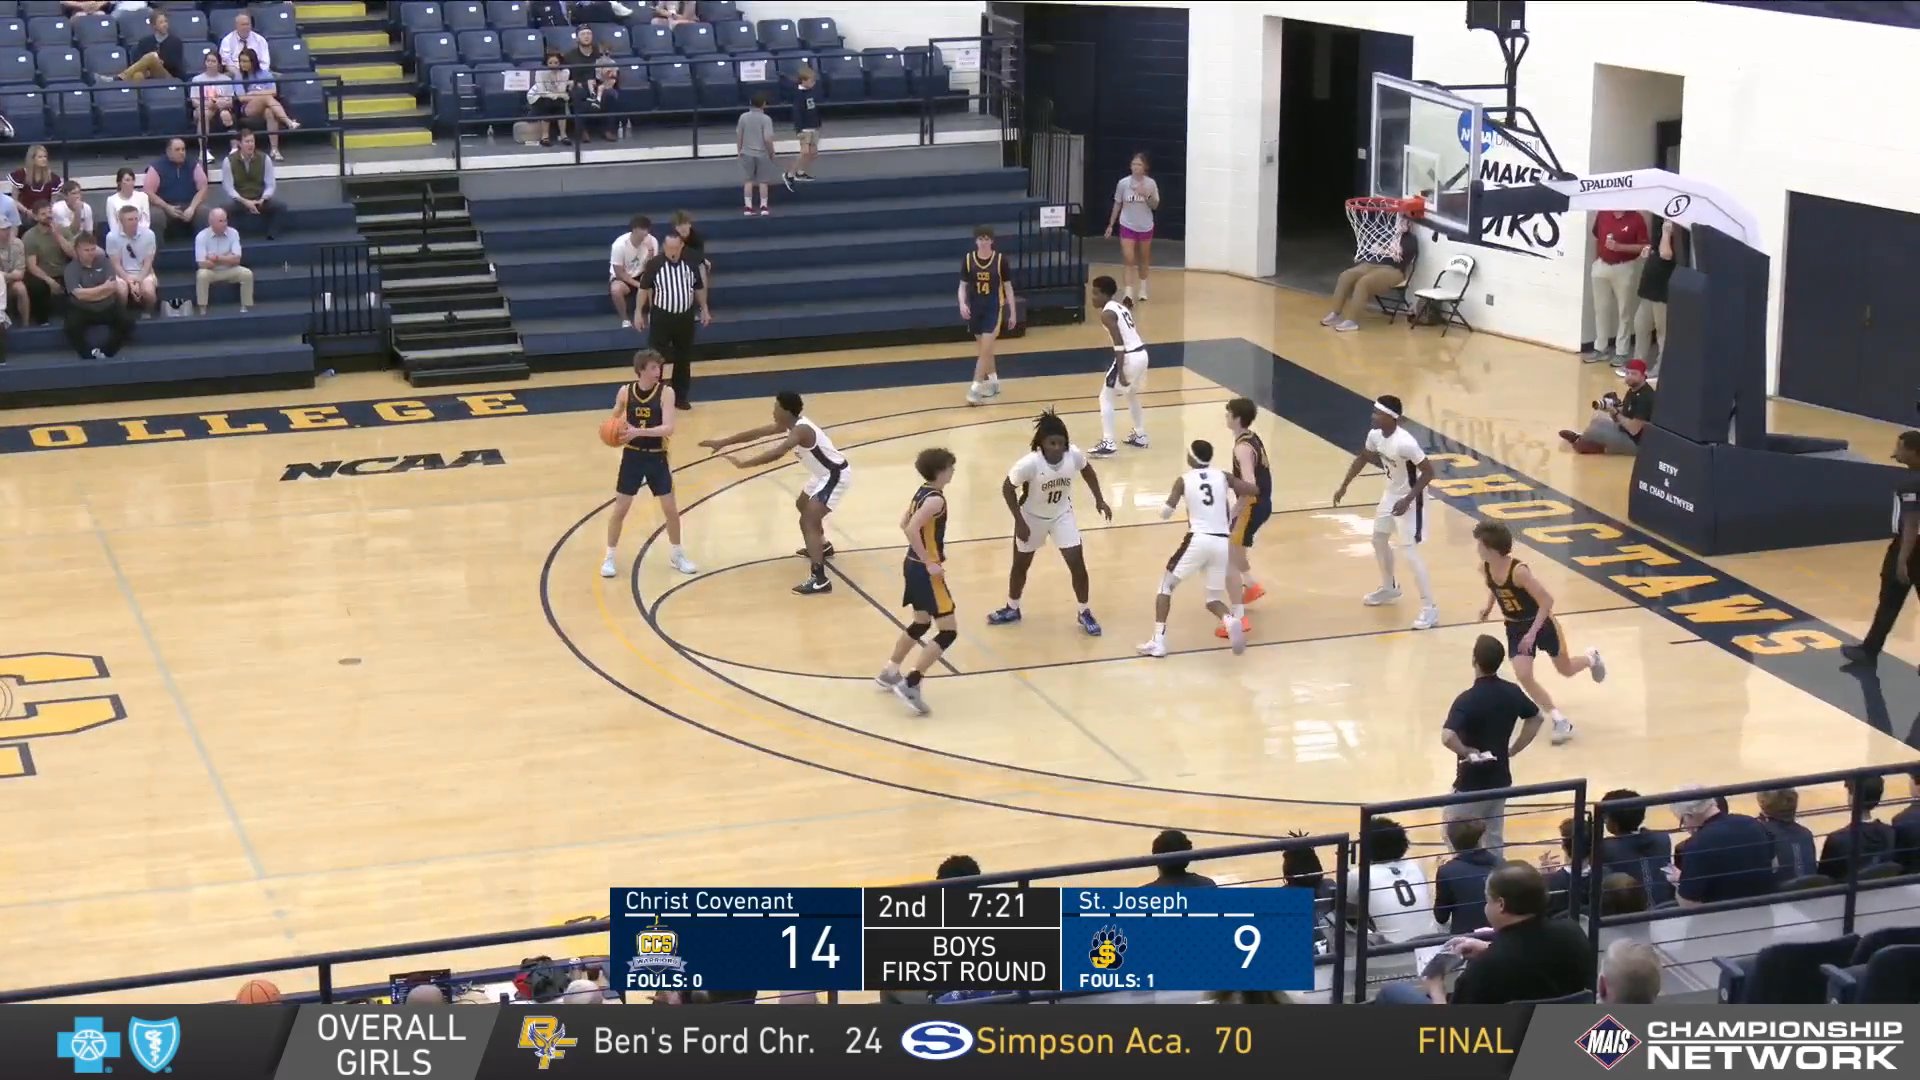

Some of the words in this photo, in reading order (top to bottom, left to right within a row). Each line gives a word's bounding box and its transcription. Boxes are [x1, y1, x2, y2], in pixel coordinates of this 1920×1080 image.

[1480, 159, 1542, 184] MAKE
[1579, 175, 1633, 192] SPALDING
[976, 282, 991, 295] 14
[279, 448, 506, 482] NCAA
[1658, 460, 1679, 477] BETSY
[1041, 477, 1071, 491] BRUINS
[1664, 478, 1670, 488] &
[1048, 490, 1062, 504] 10
[1200, 483, 1214, 506] 3
[1649, 485, 1665, 500] CHAD
[1393, 879, 1417, 907] 0
